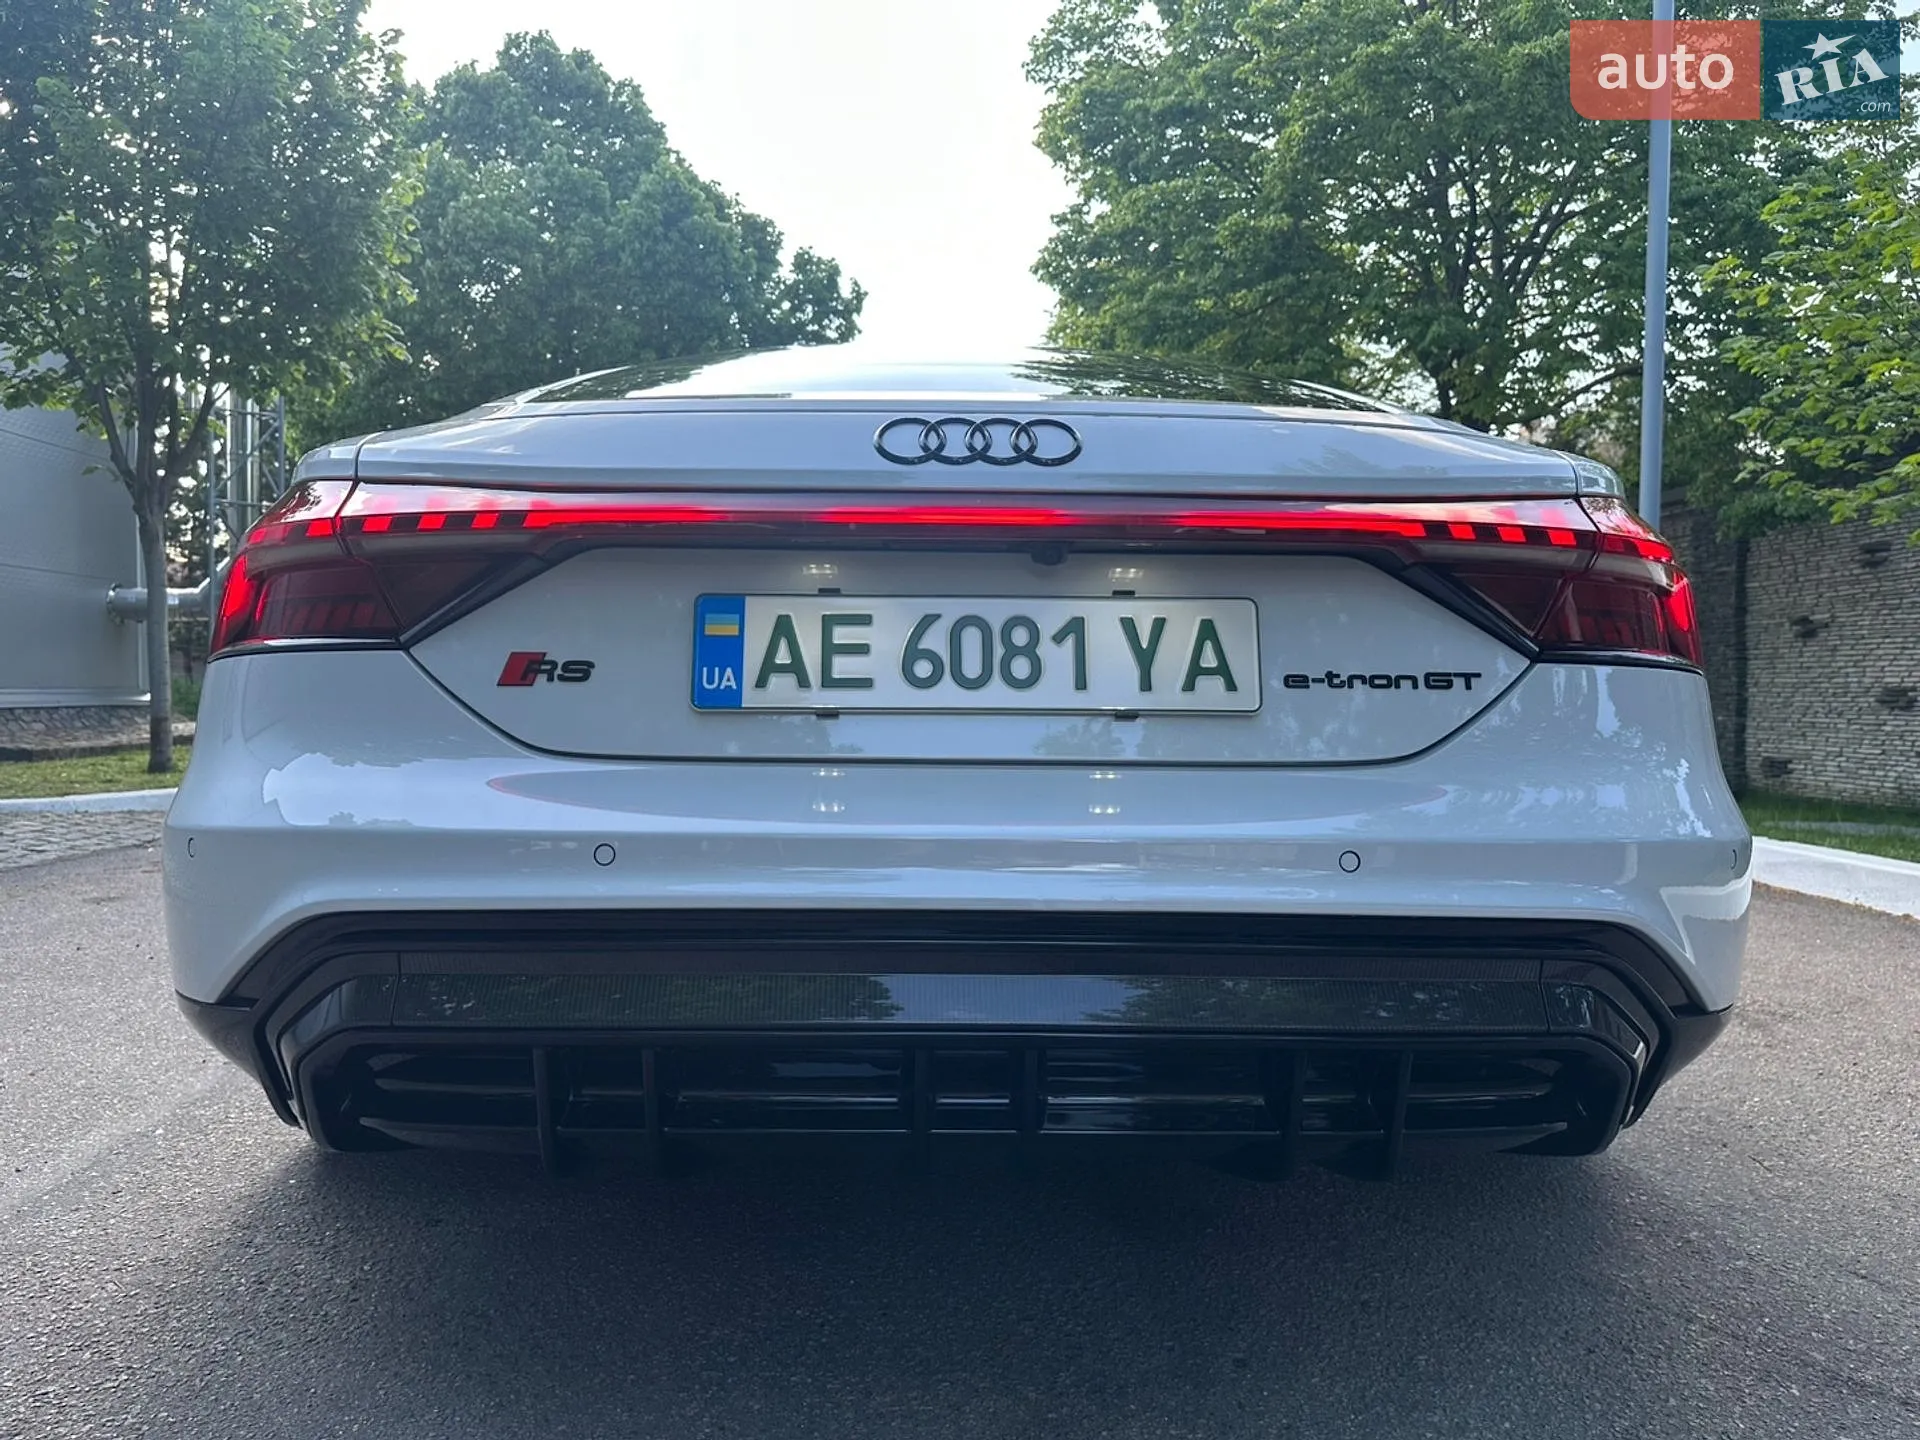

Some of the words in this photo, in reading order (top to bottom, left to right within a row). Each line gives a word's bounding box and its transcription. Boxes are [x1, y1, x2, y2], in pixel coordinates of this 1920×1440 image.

[754, 613, 874, 690] AE
[900, 613, 1087, 691] 6081
[1119, 615, 1239, 693] YA
[520, 659, 596, 683] RS
[701, 665, 738, 690] UA
